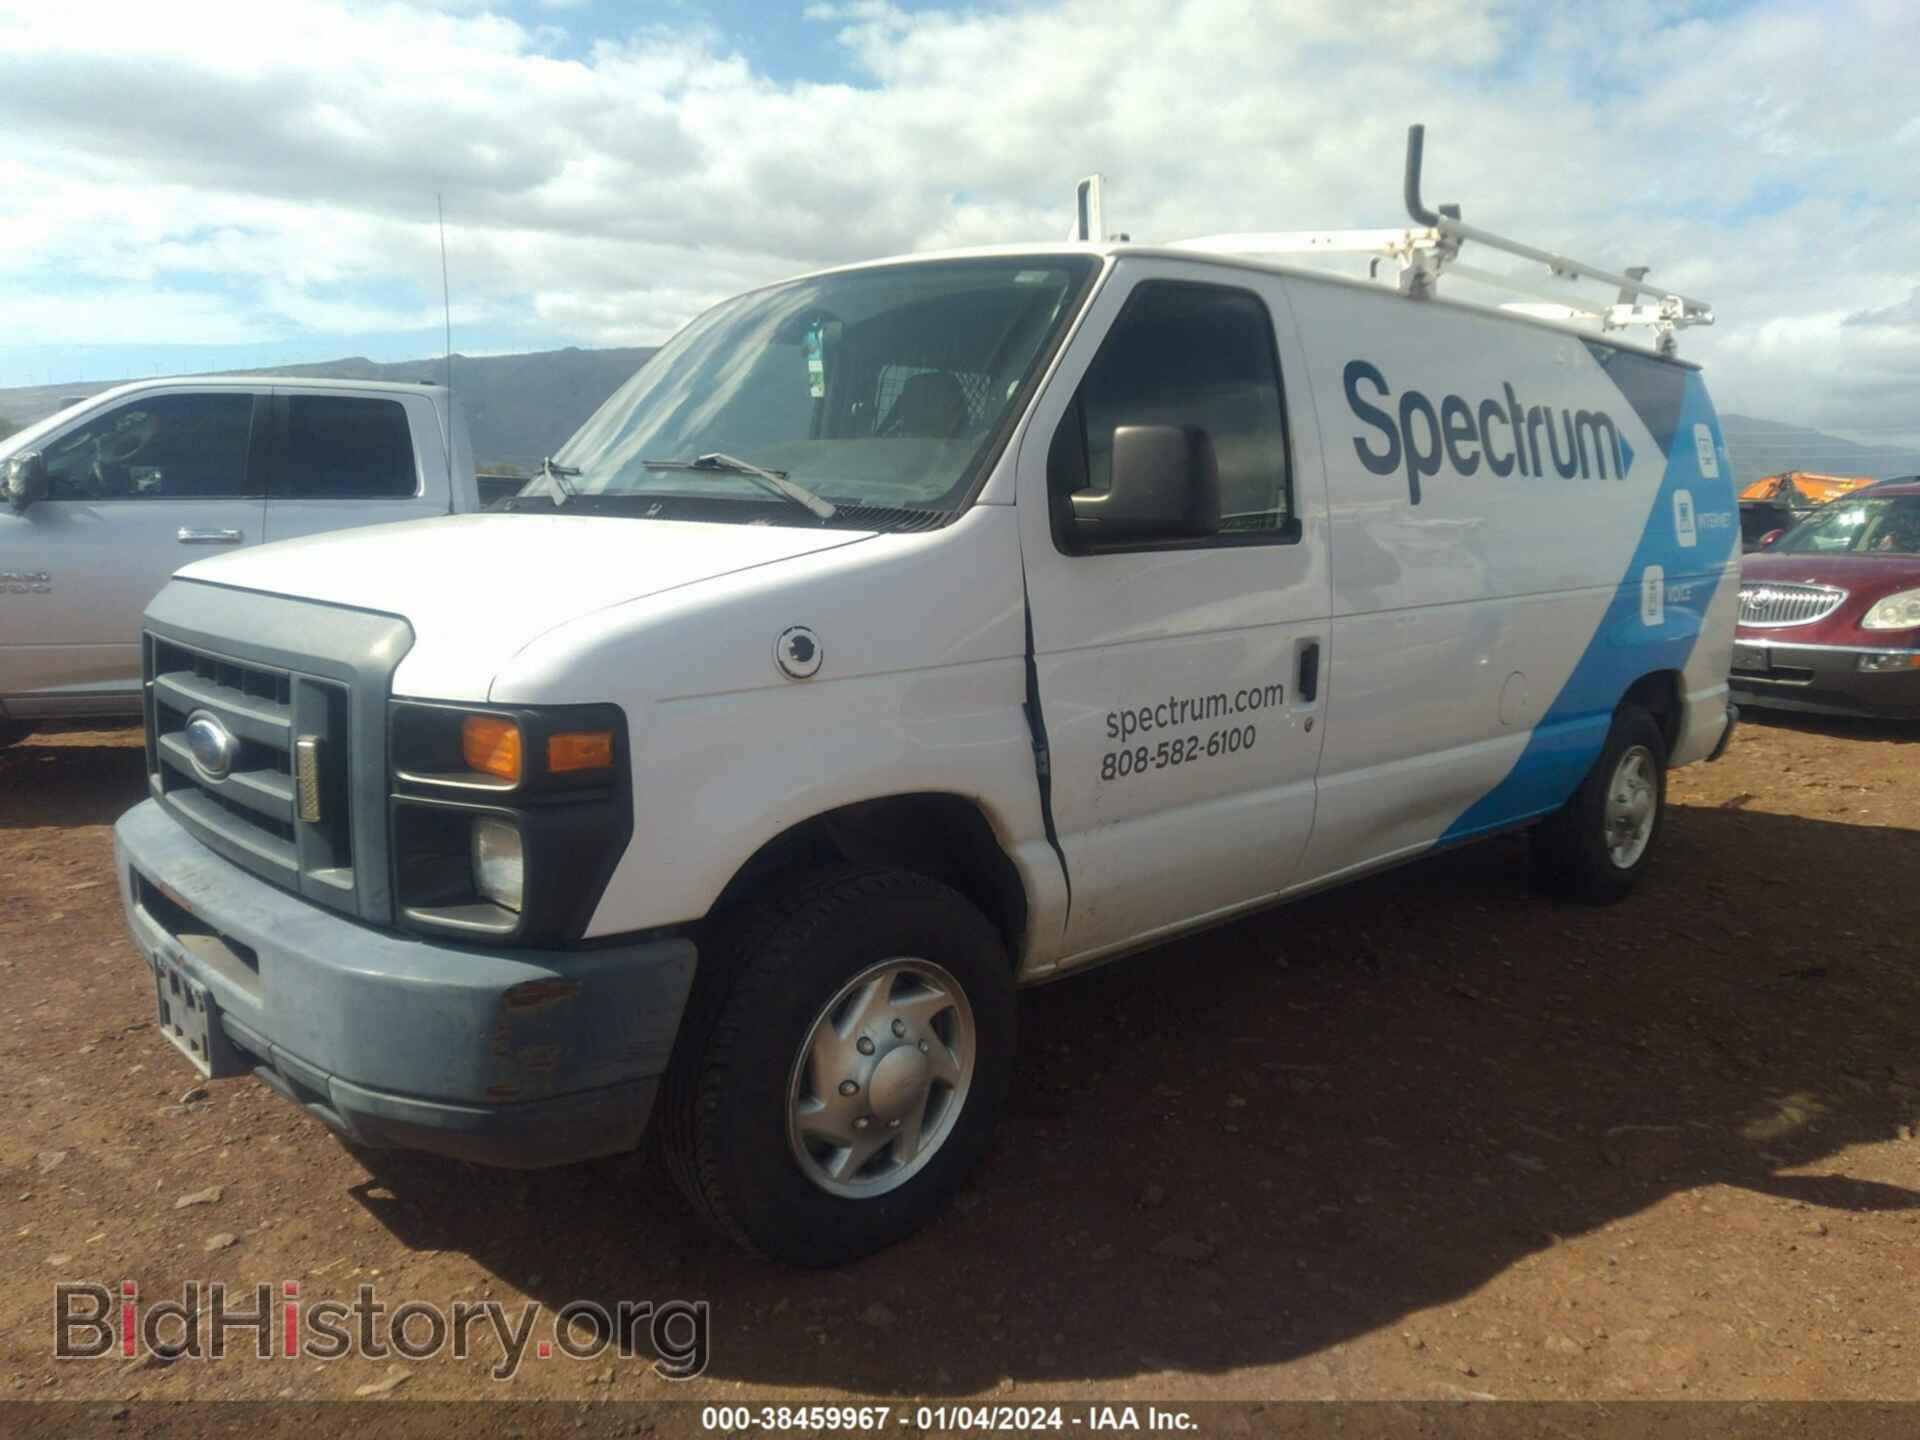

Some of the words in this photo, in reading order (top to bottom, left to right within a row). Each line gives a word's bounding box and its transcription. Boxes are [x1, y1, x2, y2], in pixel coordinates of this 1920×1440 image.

[1343, 360, 1625, 506] Spectrum
[1106, 683, 1284, 742] spectrum.com
[1101, 725, 1256, 780] 808-582-6100
